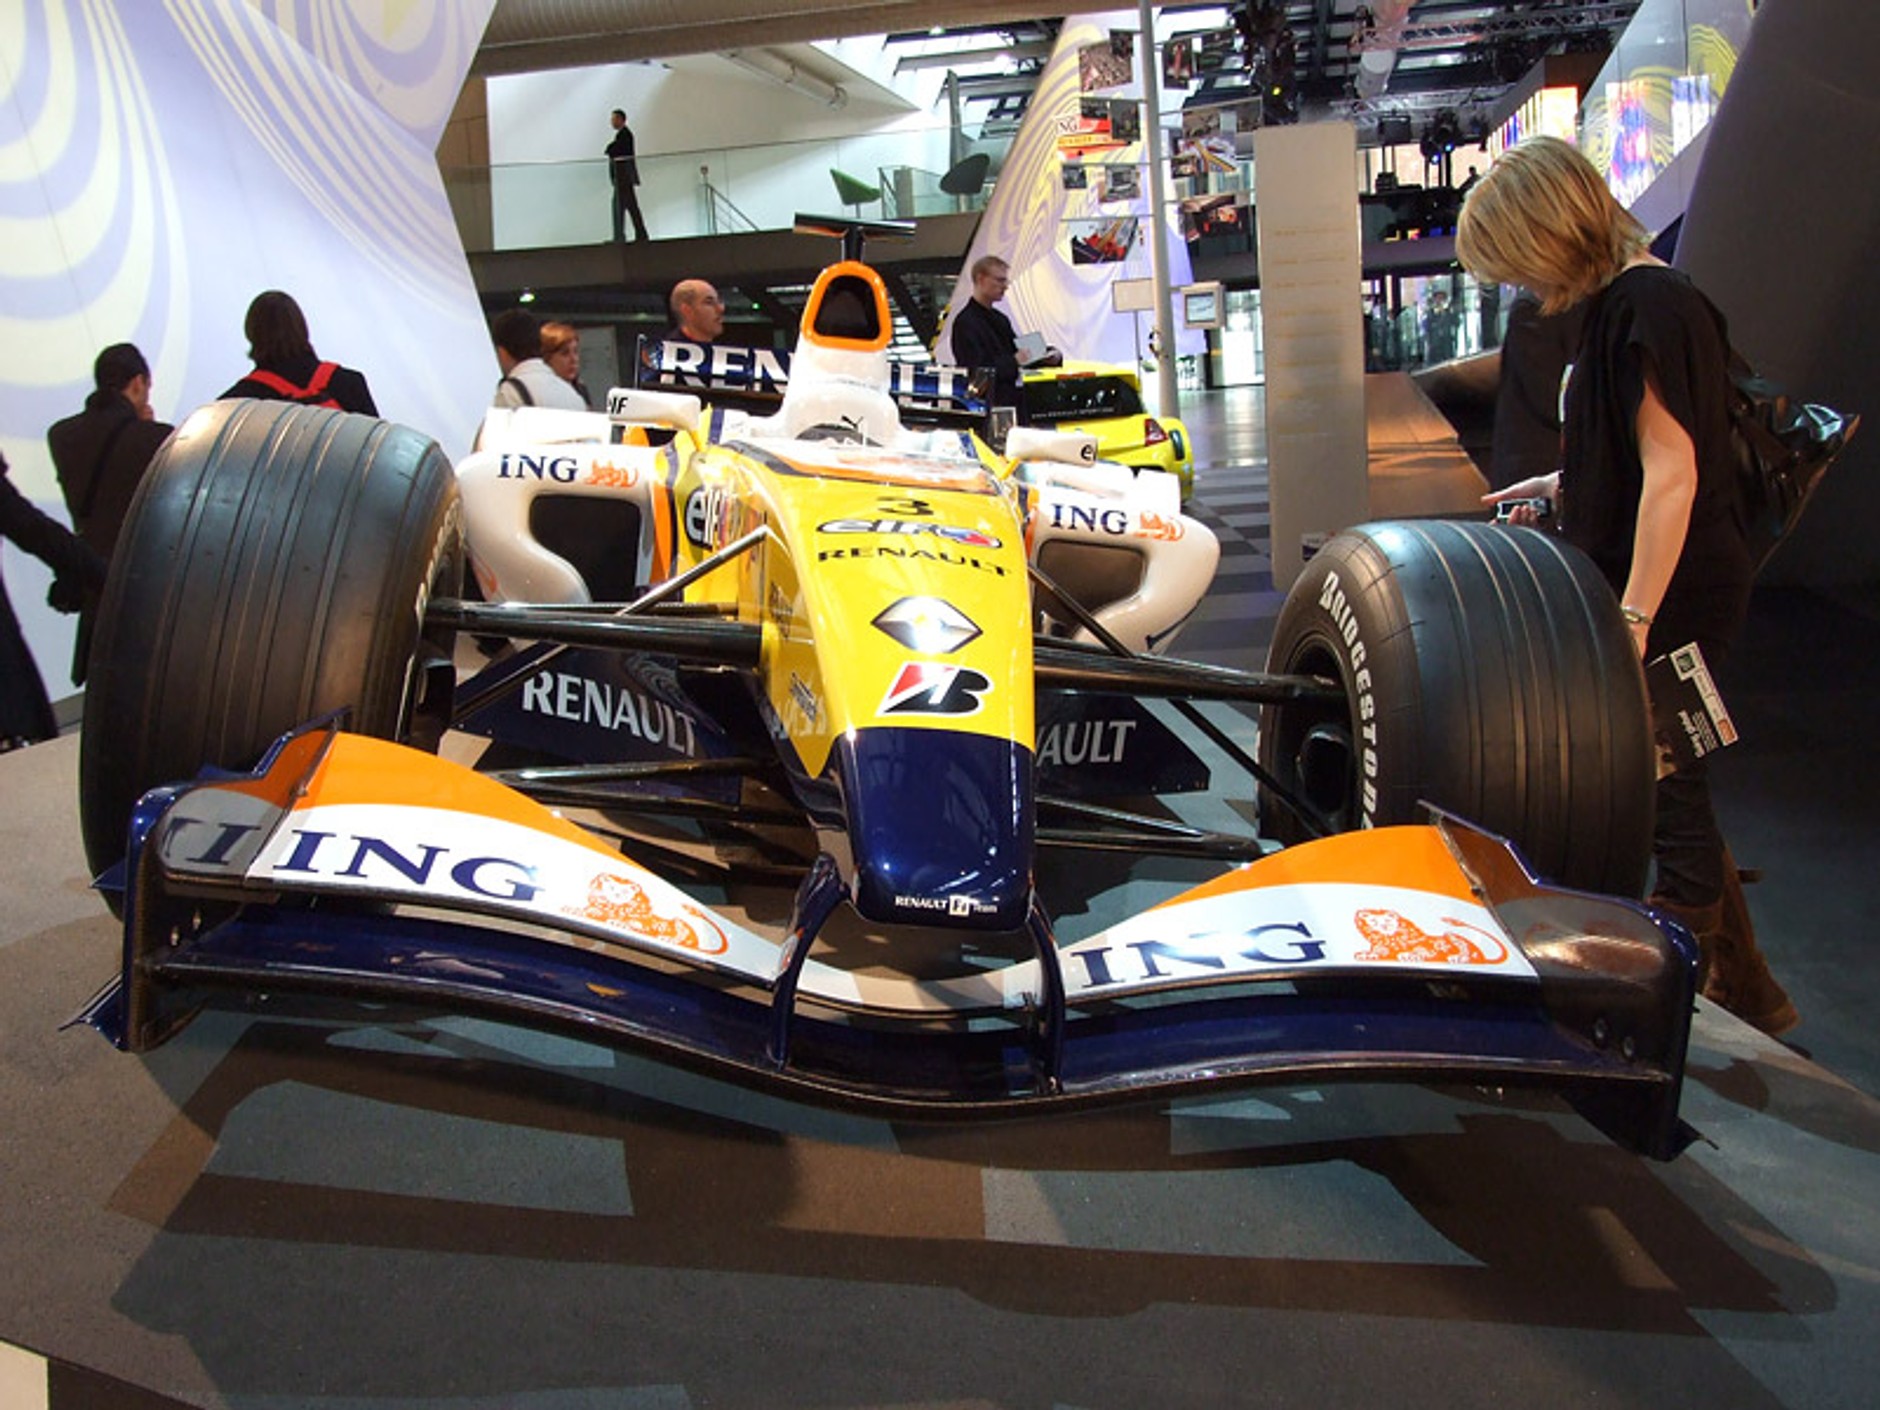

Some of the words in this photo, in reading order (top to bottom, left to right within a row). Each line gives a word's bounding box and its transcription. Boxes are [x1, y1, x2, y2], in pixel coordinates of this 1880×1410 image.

[660, 340, 968, 408] RENLT
[498, 453, 579, 483] ING
[876, 496, 934, 516] 3
[1051, 503, 1129, 535] ING
[818, 547, 1012, 577] RENAULT
[521, 669, 698, 758] RENAULT
[1035, 720, 1137, 768] AULT
[271, 828, 546, 902] ING
[895, 896, 947, 909] RENAULT
[1071, 921, 1327, 988] ING
